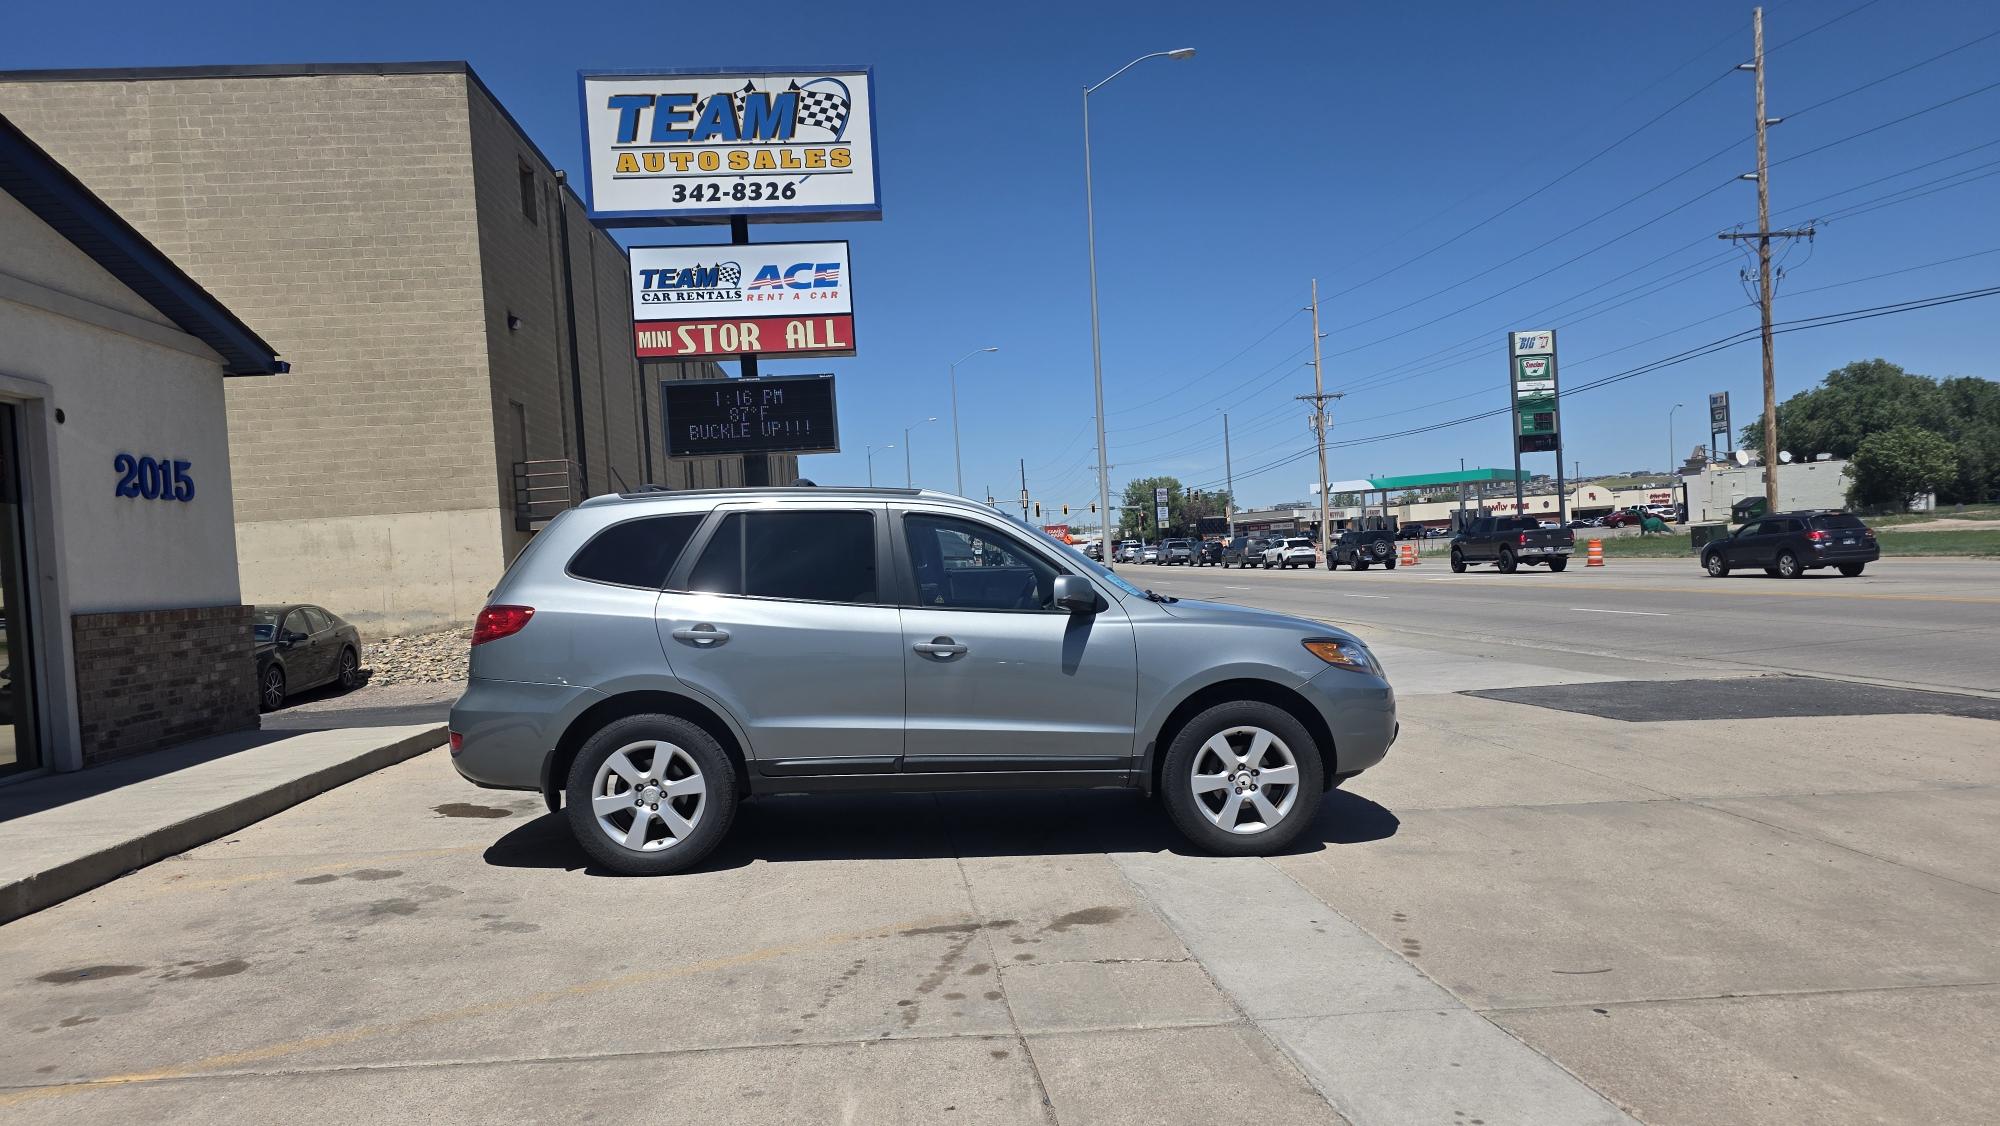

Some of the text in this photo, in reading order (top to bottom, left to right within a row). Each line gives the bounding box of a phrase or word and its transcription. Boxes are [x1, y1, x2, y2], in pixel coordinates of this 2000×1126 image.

[607, 91, 801, 143] TEAM
[671, 181, 797, 203] 342-8326
[639, 266, 721, 290] TEAM
[747, 262, 841, 291] ACE
[641, 289, 742, 302] CAR RENTALS
[746, 291, 839, 302] RENT A CAR
[638, 319, 846, 354] MINI STOR ALL
[1519, 336, 1536, 350] BIG
[1525, 361, 1545, 369] Sinclair
[715, 388, 784, 407] 1:16 PM
[689, 419, 811, 441] BUCKLE UP!!!
[114, 454, 196, 502] 2015
